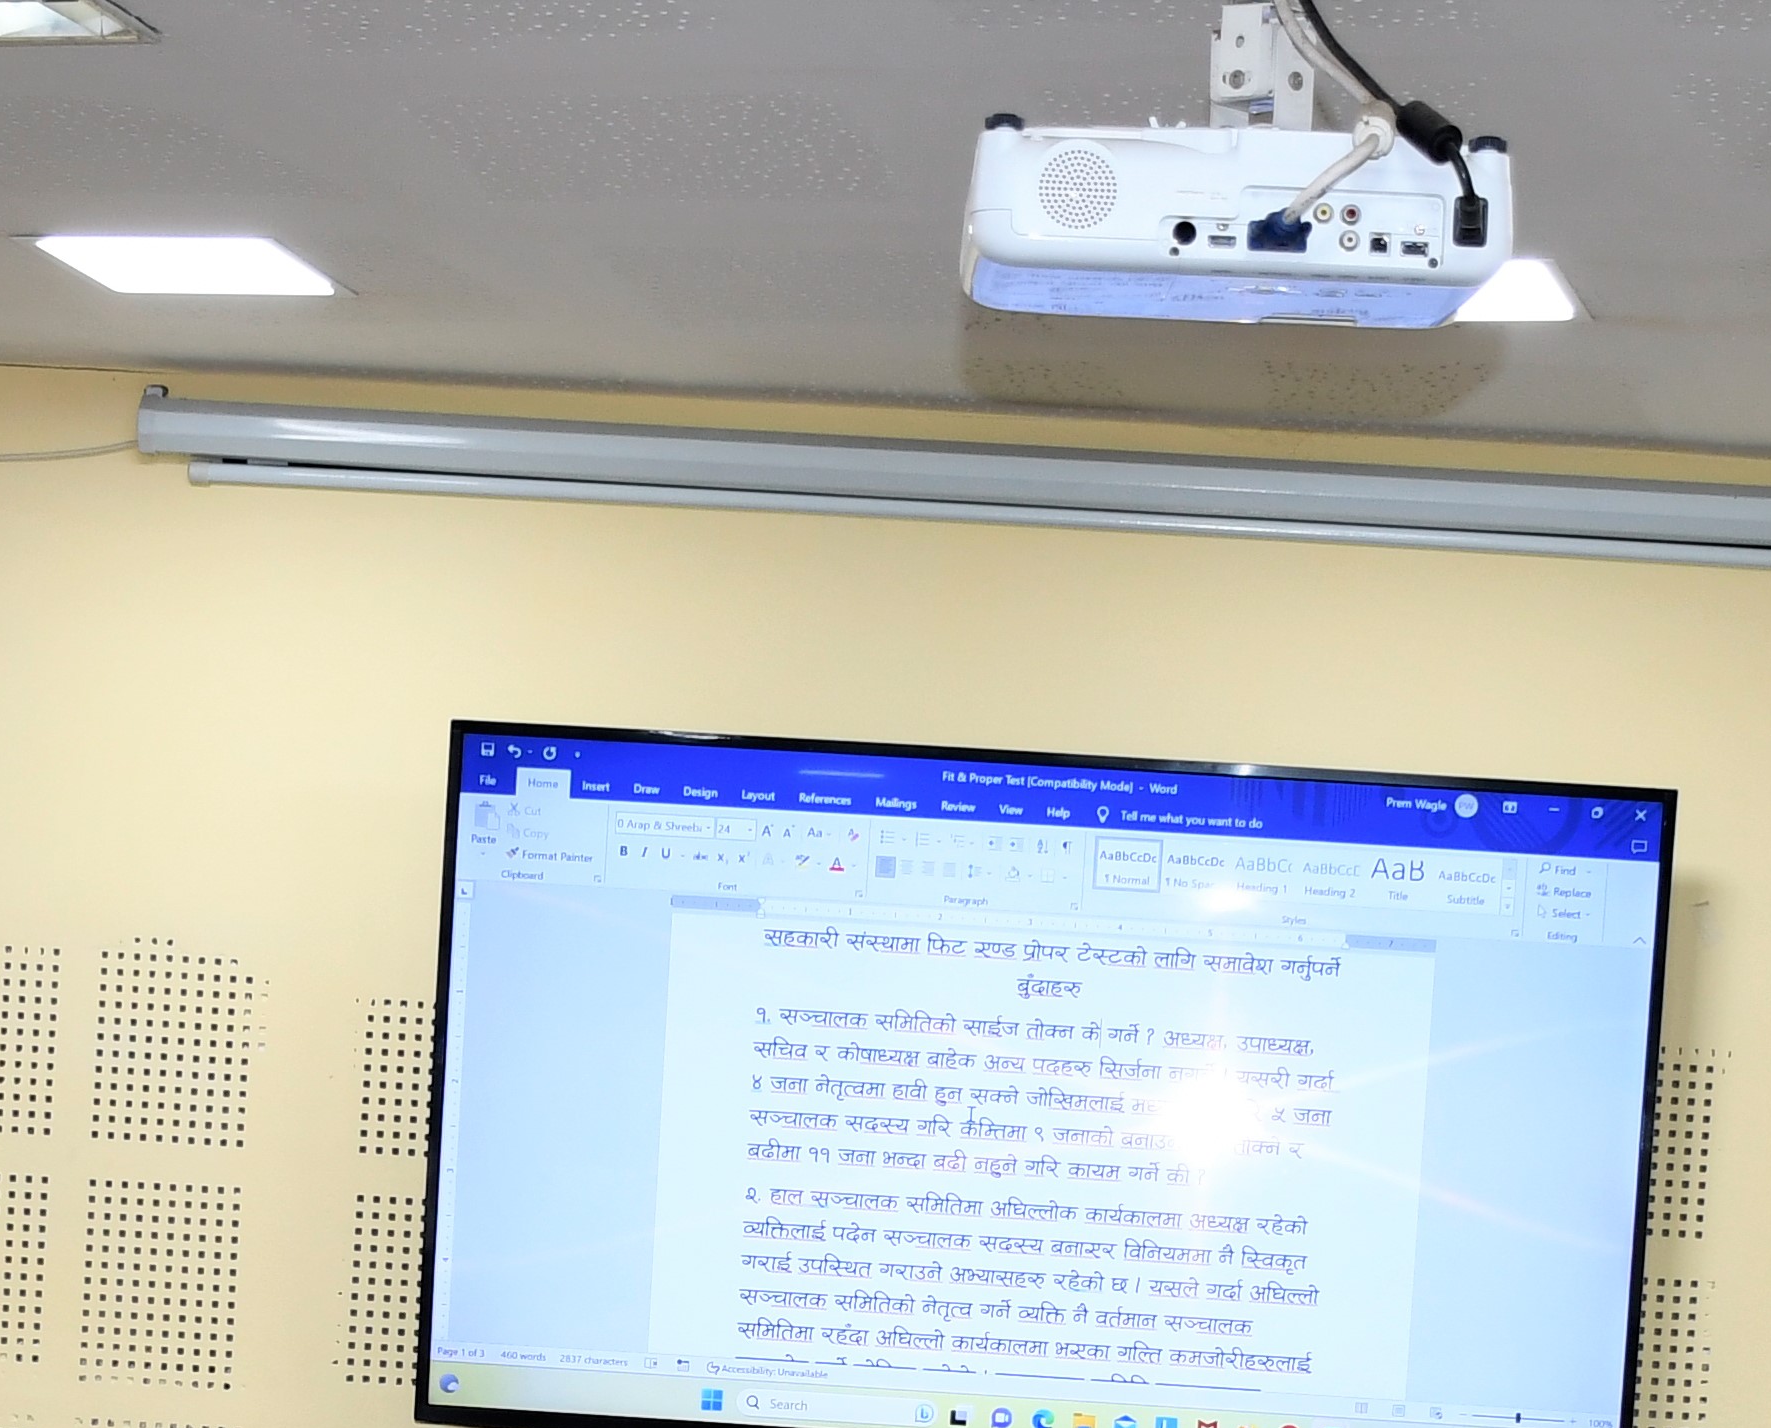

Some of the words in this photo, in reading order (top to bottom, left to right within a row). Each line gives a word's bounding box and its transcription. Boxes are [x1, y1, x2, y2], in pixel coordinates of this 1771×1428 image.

[478, 774, 497, 787] File
[527, 777, 559, 790] Home
[581, 780, 611, 793] Insert
[941, 770, 955, 782] Fit
[968, 772, 1003, 787] Proper
[1004, 774, 1025, 786] Test
[1027, 775, 1098, 792] [Compatibility
[1149, 782, 1177, 795] Word
[633, 783, 660, 795] Draw
[683, 785, 718, 800] Design
[741, 789, 775, 803] Layout
[798, 791, 852, 807] References
[875, 796, 917, 811] Mailings
[1385, 797, 1411, 809] Prem
[1413, 798, 1447, 813] Wagle
[523, 805, 542, 817] Cut
[940, 800, 976, 813] Review
[998, 803, 1023, 816] View
[1045, 805, 1071, 820] Help
[1120, 809, 1137, 821] Tell
[1157, 810, 1184, 824] what
[1184, 816, 1204, 829] you
[1205, 815, 1233, 827] want
[470, 833, 497, 845] Paste
[522, 827, 549, 841] Copy
[521, 849, 558, 862] Format
[561, 851, 593, 864] Painter
[500, 869, 544, 882] Clipboard
[1554, 864, 1577, 876] Find
[717, 881, 738, 892] Font
[1303, 885, 1345, 899] Heading
[1387, 889, 1408, 902] Title
[1445, 893, 1485, 907] Subtitle
[1552, 887, 1592, 901] Replace
[943, 895, 989, 908] Paragraph
[1551, 908, 1582, 920] Select
[1546, 930, 1578, 944] Editing
[764, 926, 839, 949] सहकारी
[846, 931, 921, 953] संस्थामा
[928, 932, 967, 955] फिट
[1022, 939, 1070, 963] प्रोपर
[1077, 943, 1147, 966] टेस्टको
[1154, 947, 1196, 969] लागि
[1203, 952, 1273, 973] समावेश
[875, 1009, 957, 1033] समितिको
[1107, 1023, 1140, 1044] गर्ने
[753, 1036, 808, 1060] सचिव
[926, 1048, 977, 1070] बाहेक
[984, 1055, 1026, 1073] अन्य
[1099, 1057, 1162, 1080] सिर्जना
[1237, 1067, 1290, 1090] यसरी
[770, 1076, 808, 1094] जना
[815, 1074, 886, 1100] नेतृत्वमा
[892, 1079, 928, 1099] हावी
[934, 1086, 963, 1107] हुन
[969, 1085, 1019, 1106] सक्ने
[1294, 1108, 1333, 1126] जना
[845, 1115, 910, 1134] सदस्य
[917, 1114, 953, 1137] गरि
[1053, 1126, 1114, 1147] जनाको
[809, 1147, 830, 1163] ११
[838, 1149, 876, 1166] जना
[883, 1151, 926, 1169] भन्दा
[933, 1149, 967, 1171] बढी
[974, 1154, 1018, 1178] नहुने
[1025, 1154, 1060, 1177] गरि
[1067, 1163, 1122, 1181] कायम
[1128, 1162, 1161, 1182] गर्ने
[770, 1188, 804, 1206] हाल
[907, 1191, 984, 1215] समितिमा
[1085, 1204, 1182, 1229] कार्यकालमा
[1190, 1213, 1250, 1233] अध्यक्ष
[1256, 1214, 1309, 1236] रहेको
[832, 1222, 877, 1244] पदेन
[979, 1235, 1044, 1254] सदस्य
[1124, 1238, 1212, 1264] विनियममा
[741, 1251, 792, 1274] गराई
[798, 1253, 873, 1278] उपस्थित
[879, 1261, 943, 1282] गराउने
[1053, 1270, 1105, 1292] रहेको
[1148, 1277, 1200, 1299] यसले
[1249, 1282, 1319, 1305] अघिल्लो
[834, 1289, 916, 1313] समितिको
[922, 1295, 974, 1322] नेतृत्व
[980, 1299, 1012, 1320] गर्ने
[1018, 1301, 1067, 1324] व्यक्ति
[1095, 1306, 1158, 1330] वर्तमान
[737, 1316, 815, 1341] समितिमा
[875, 1325, 945, 1349] अघिल्लो
[951, 1332, 1049, 1356] कार्यकालमा
[436, 1345, 459, 1358] Page
[519, 1352, 546, 1362] words
[583, 1356, 629, 1367] characters
[769, 1397, 809, 1412] Search
